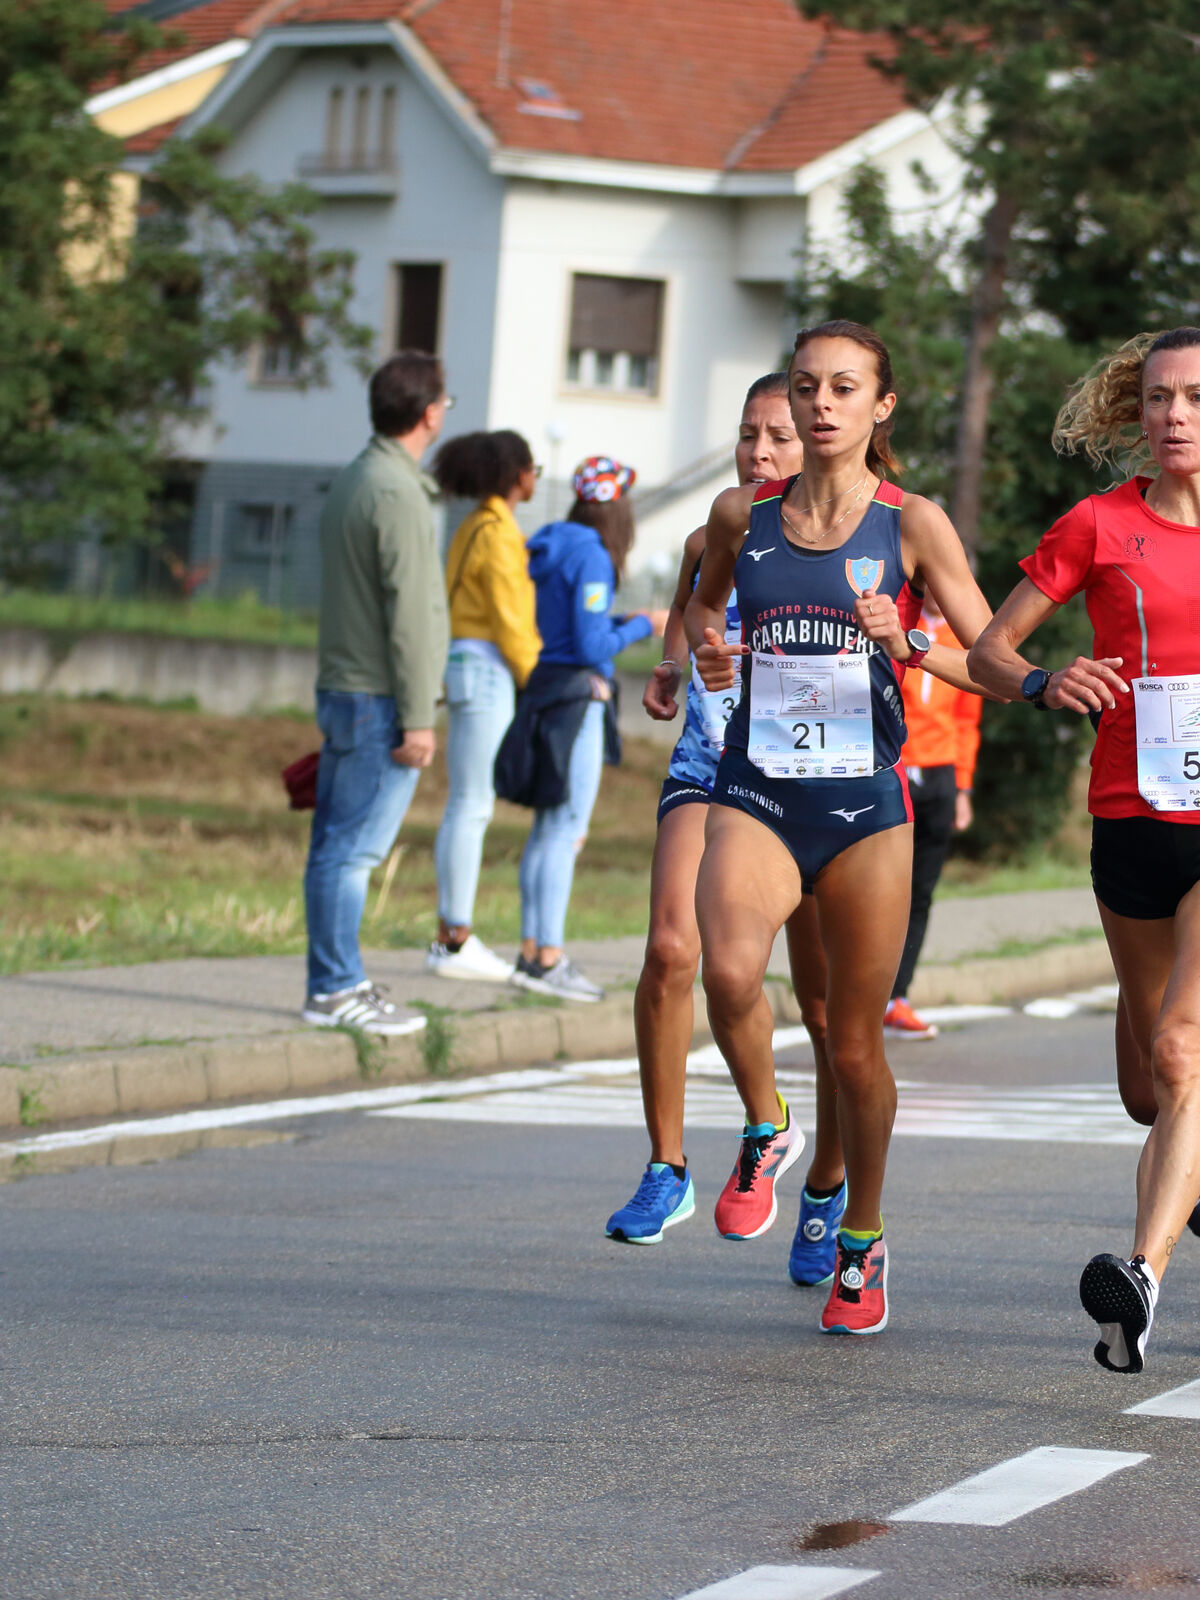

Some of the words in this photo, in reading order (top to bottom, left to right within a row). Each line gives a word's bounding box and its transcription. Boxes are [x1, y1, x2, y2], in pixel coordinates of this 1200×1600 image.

[757, 605, 801, 622] CENTRO
[807, 605, 857, 623] SPORTIV
[752, 620, 875, 655] CARABINIERI
[1138, 682, 1164, 691] BOSCA
[792, 722, 825, 750] 21
[727, 784, 784, 818] CARABINIERI
